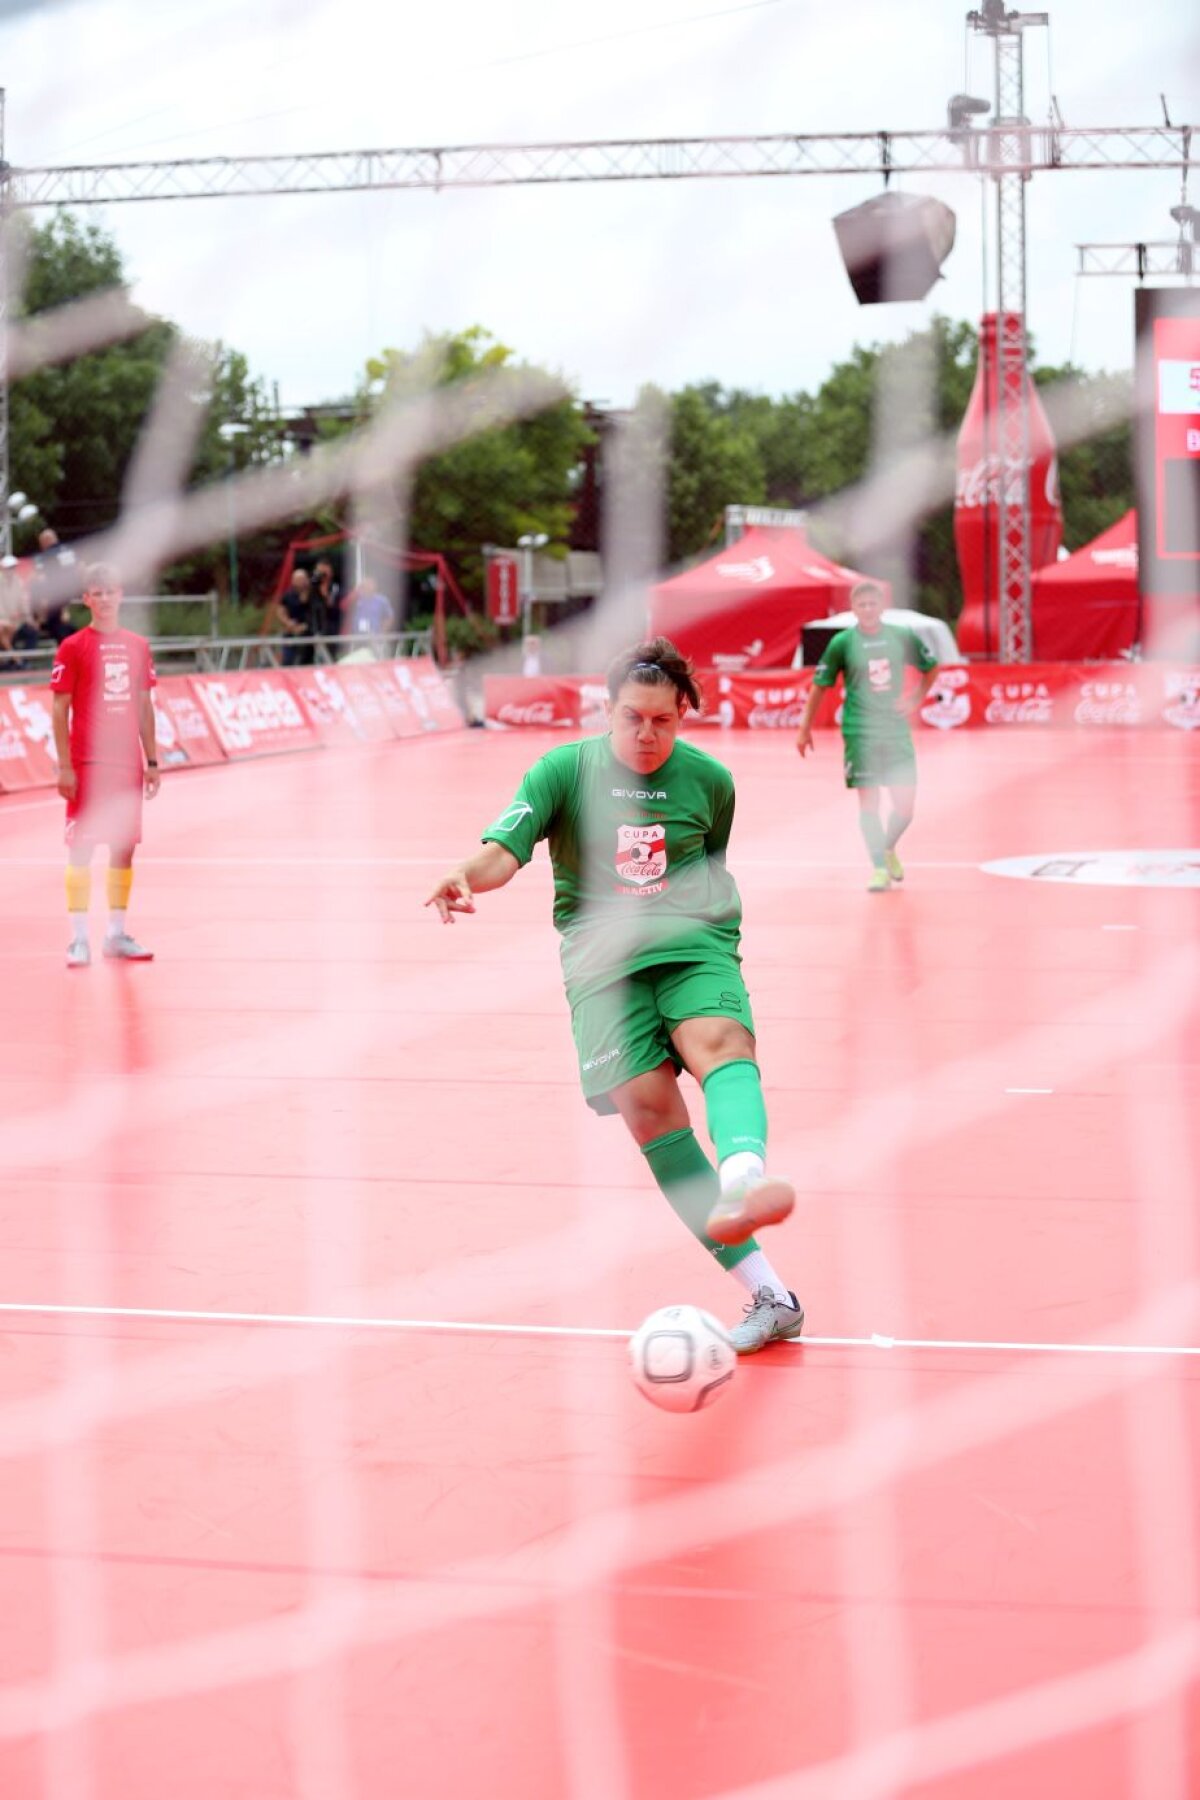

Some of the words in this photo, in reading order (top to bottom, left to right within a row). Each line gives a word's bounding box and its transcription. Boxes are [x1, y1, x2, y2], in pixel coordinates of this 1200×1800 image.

[990, 683, 1049, 699] CUPA
[1080, 683, 1137, 699] CUPA
[611, 788, 668, 800] GIVOVA
[623, 830, 659, 839] CUPA
